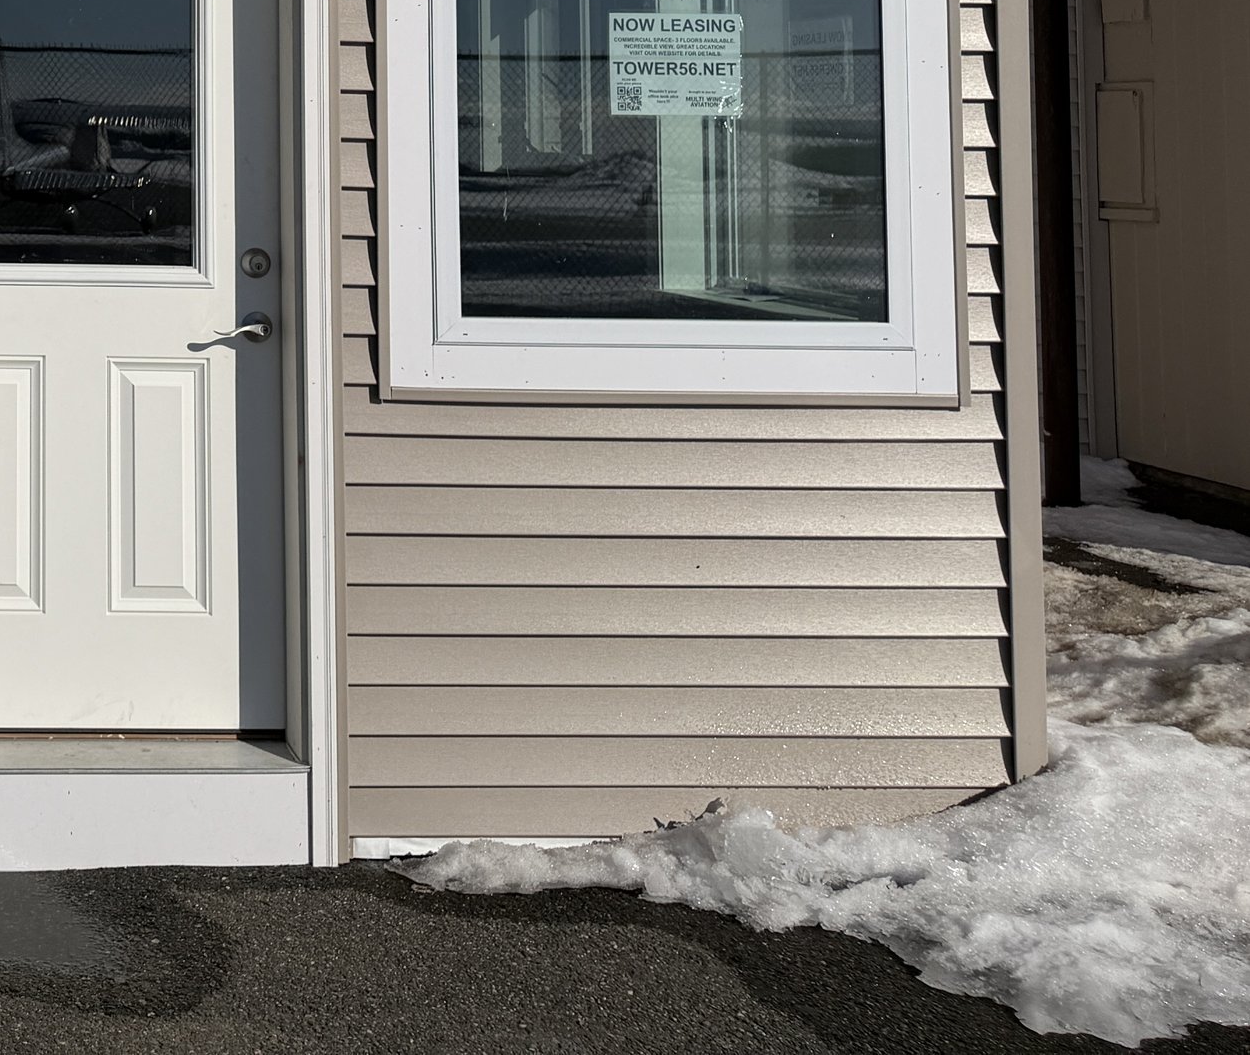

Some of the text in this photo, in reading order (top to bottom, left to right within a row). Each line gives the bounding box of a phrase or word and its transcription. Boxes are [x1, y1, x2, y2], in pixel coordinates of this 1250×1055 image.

[613, 18, 736, 33] NOW LEASING
[613, 61, 737, 76] TOWER56.NET
